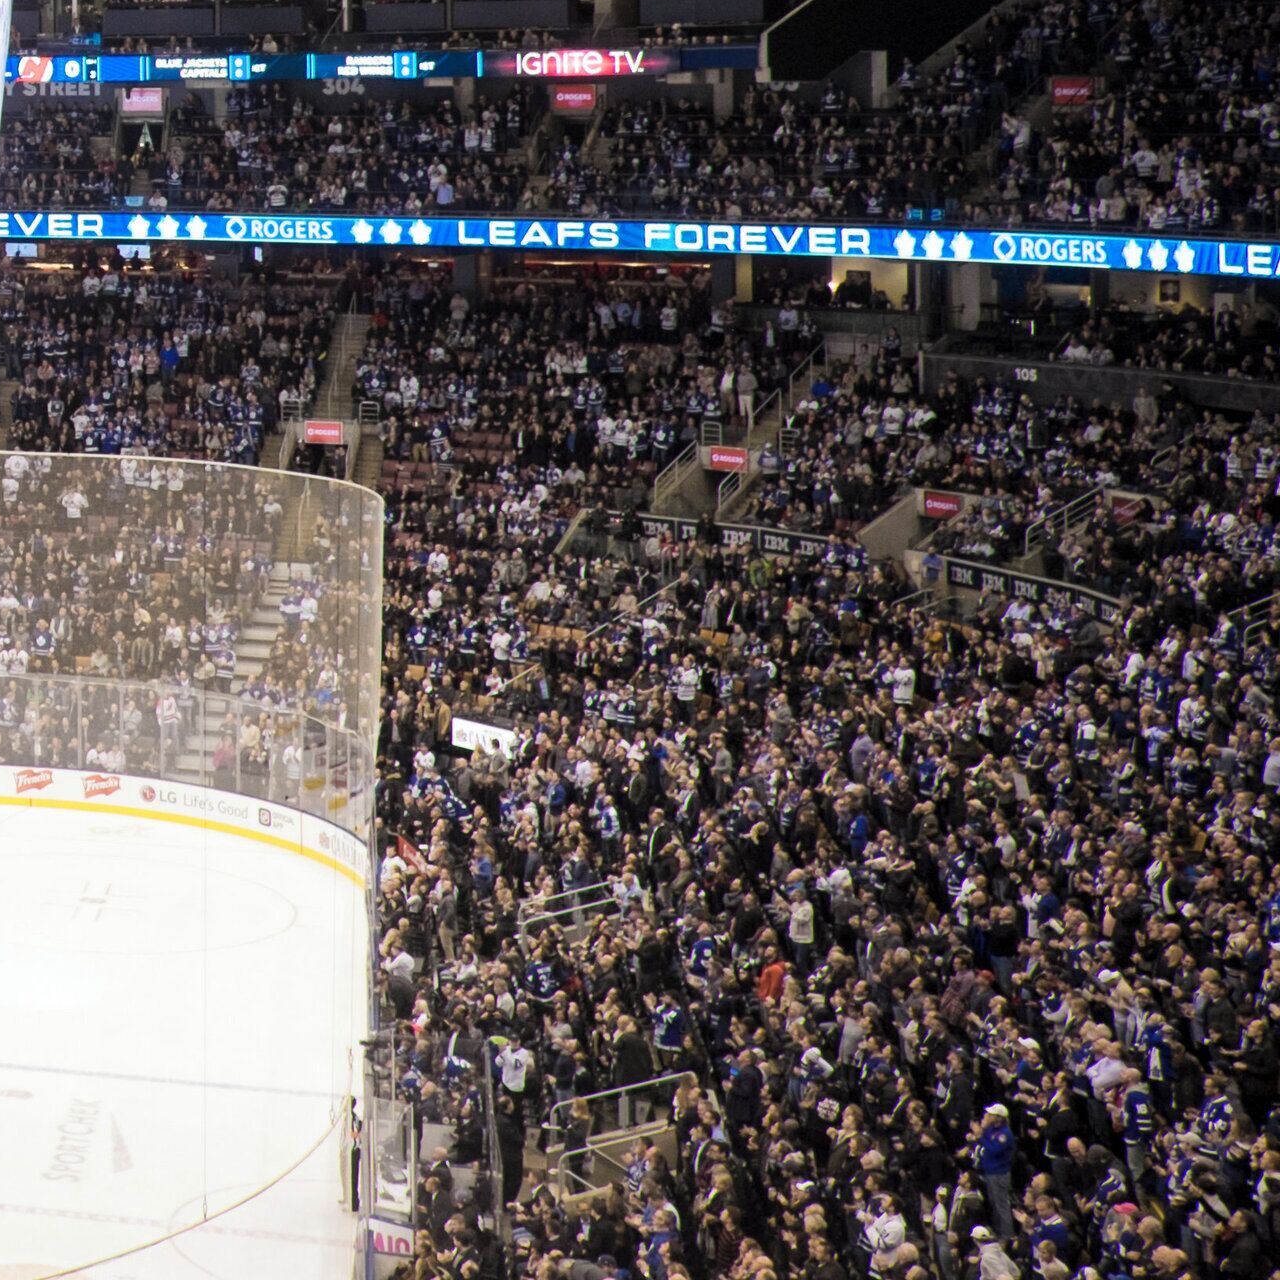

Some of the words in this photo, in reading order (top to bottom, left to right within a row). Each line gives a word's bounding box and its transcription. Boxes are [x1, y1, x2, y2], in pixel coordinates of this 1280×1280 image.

[65, 60, 80, 77] 0
[180, 69, 227, 78] CAPITALS
[23, 81, 101, 97] STREET
[322, 78, 365, 96] 304
[564, 93, 591, 101] ROGERS
[251, 220, 332, 239] ROGERS
[458, 221, 618, 247] LEAFS
[644, 223, 869, 255] FOREVER
[1021, 238, 1105, 262] ROGERS
[1015, 368, 1038, 381] 105
[933, 500, 957, 510] ROGERS
[643, 521, 668, 535] IBM
[682, 525, 697, 538] IB
[722, 529, 751, 546] IBM
[763, 535, 790, 551] IBM
[950, 566, 972, 585] IBM
[982, 574, 1004, 591] IBM
[1013, 581, 1037, 600] IBM
[17, 772, 52, 786] French's
[86, 778, 121, 793] French's
[159, 791, 177, 803] LG
[183, 792, 214, 811] Life's
[217, 800, 248, 820] Good
[42, 1096, 102, 1183] SPORTCHEK
